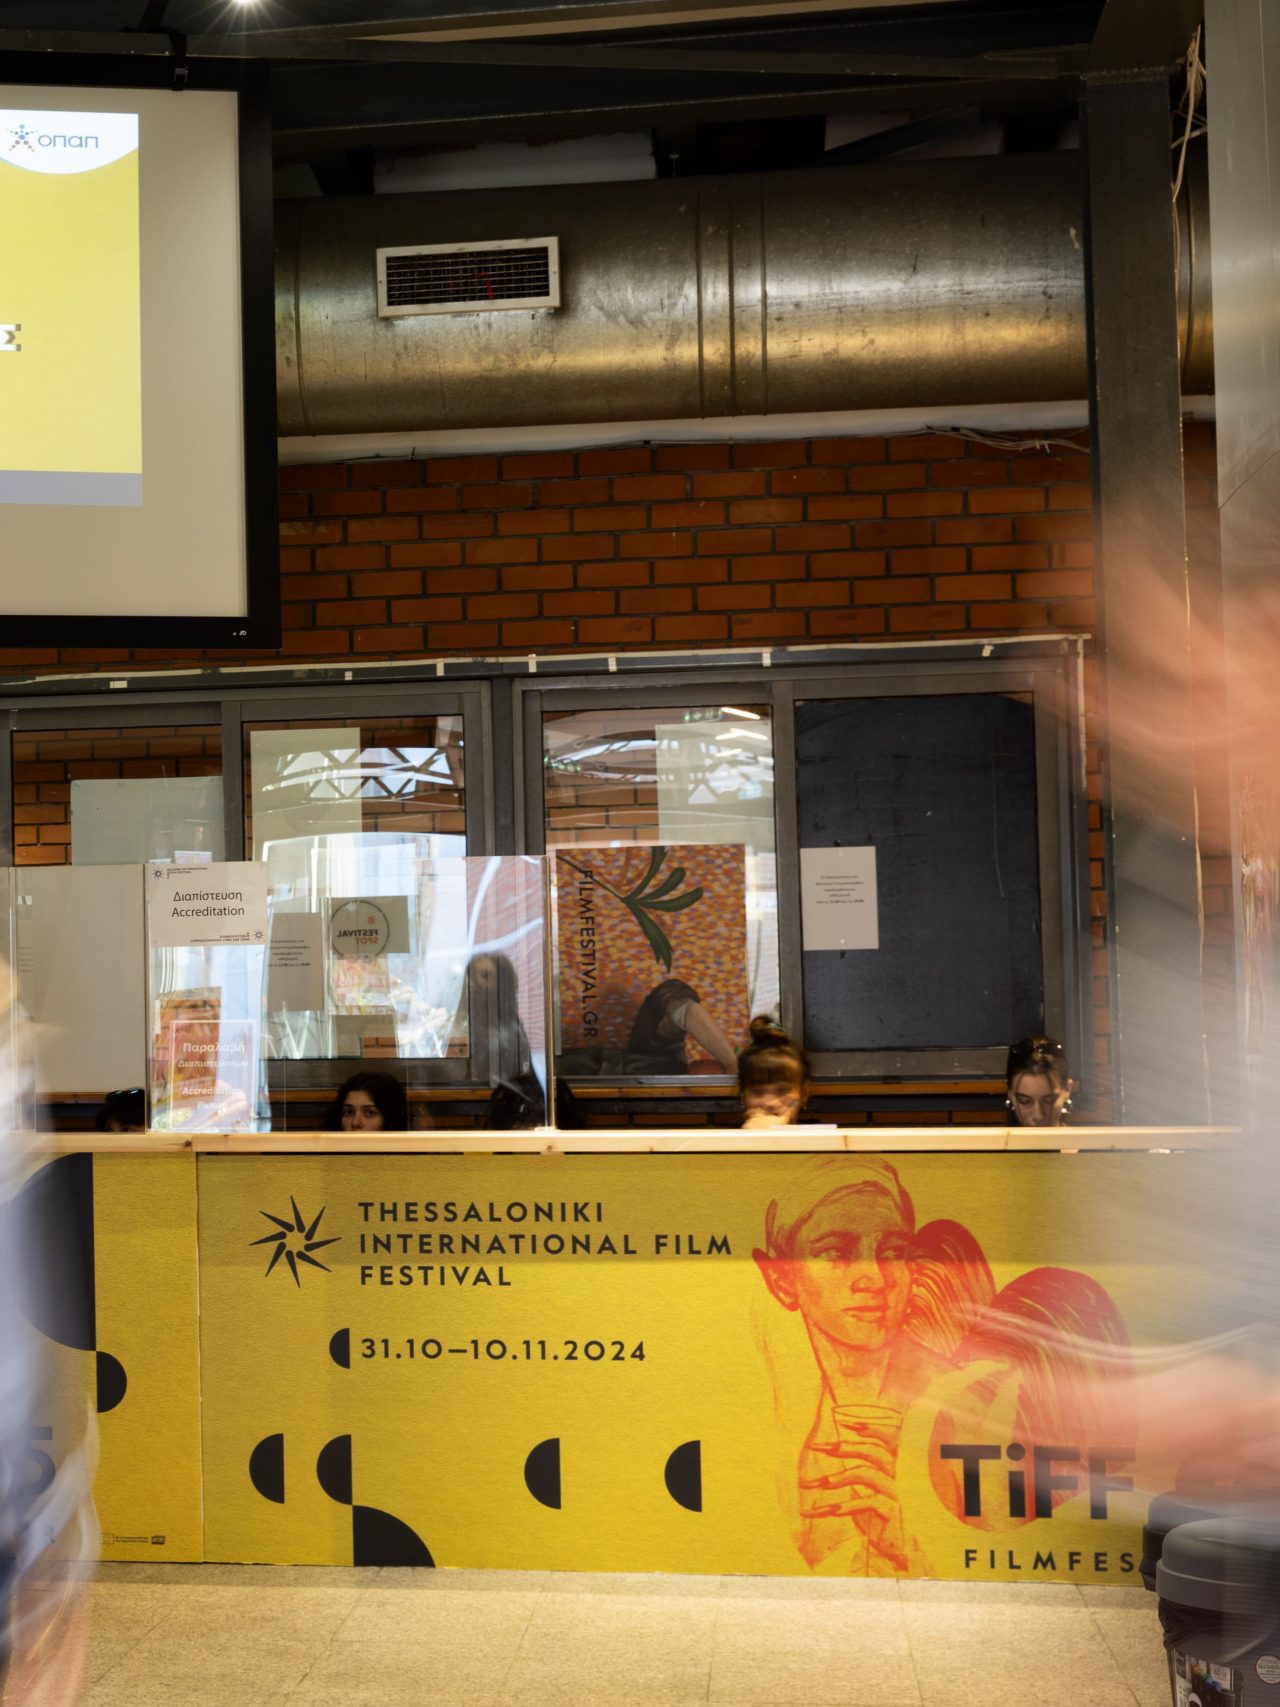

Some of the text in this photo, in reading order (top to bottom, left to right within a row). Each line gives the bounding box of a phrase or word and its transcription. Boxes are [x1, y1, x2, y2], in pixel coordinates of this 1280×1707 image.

[173, 891, 243, 902] Διαπίστευση
[171, 906, 245, 917] Accreditation
[578, 870, 598, 1039] FILMFESTIVAL.GR
[358, 1201, 602, 1223] THESSALONIKI
[360, 1233, 732, 1255] INTERNATIONAL FILM
[360, 1265, 511, 1286] FESTIVAL
[940, 1442, 1136, 1520] TiFF
[964, 1549, 1135, 1572] FILMFES
